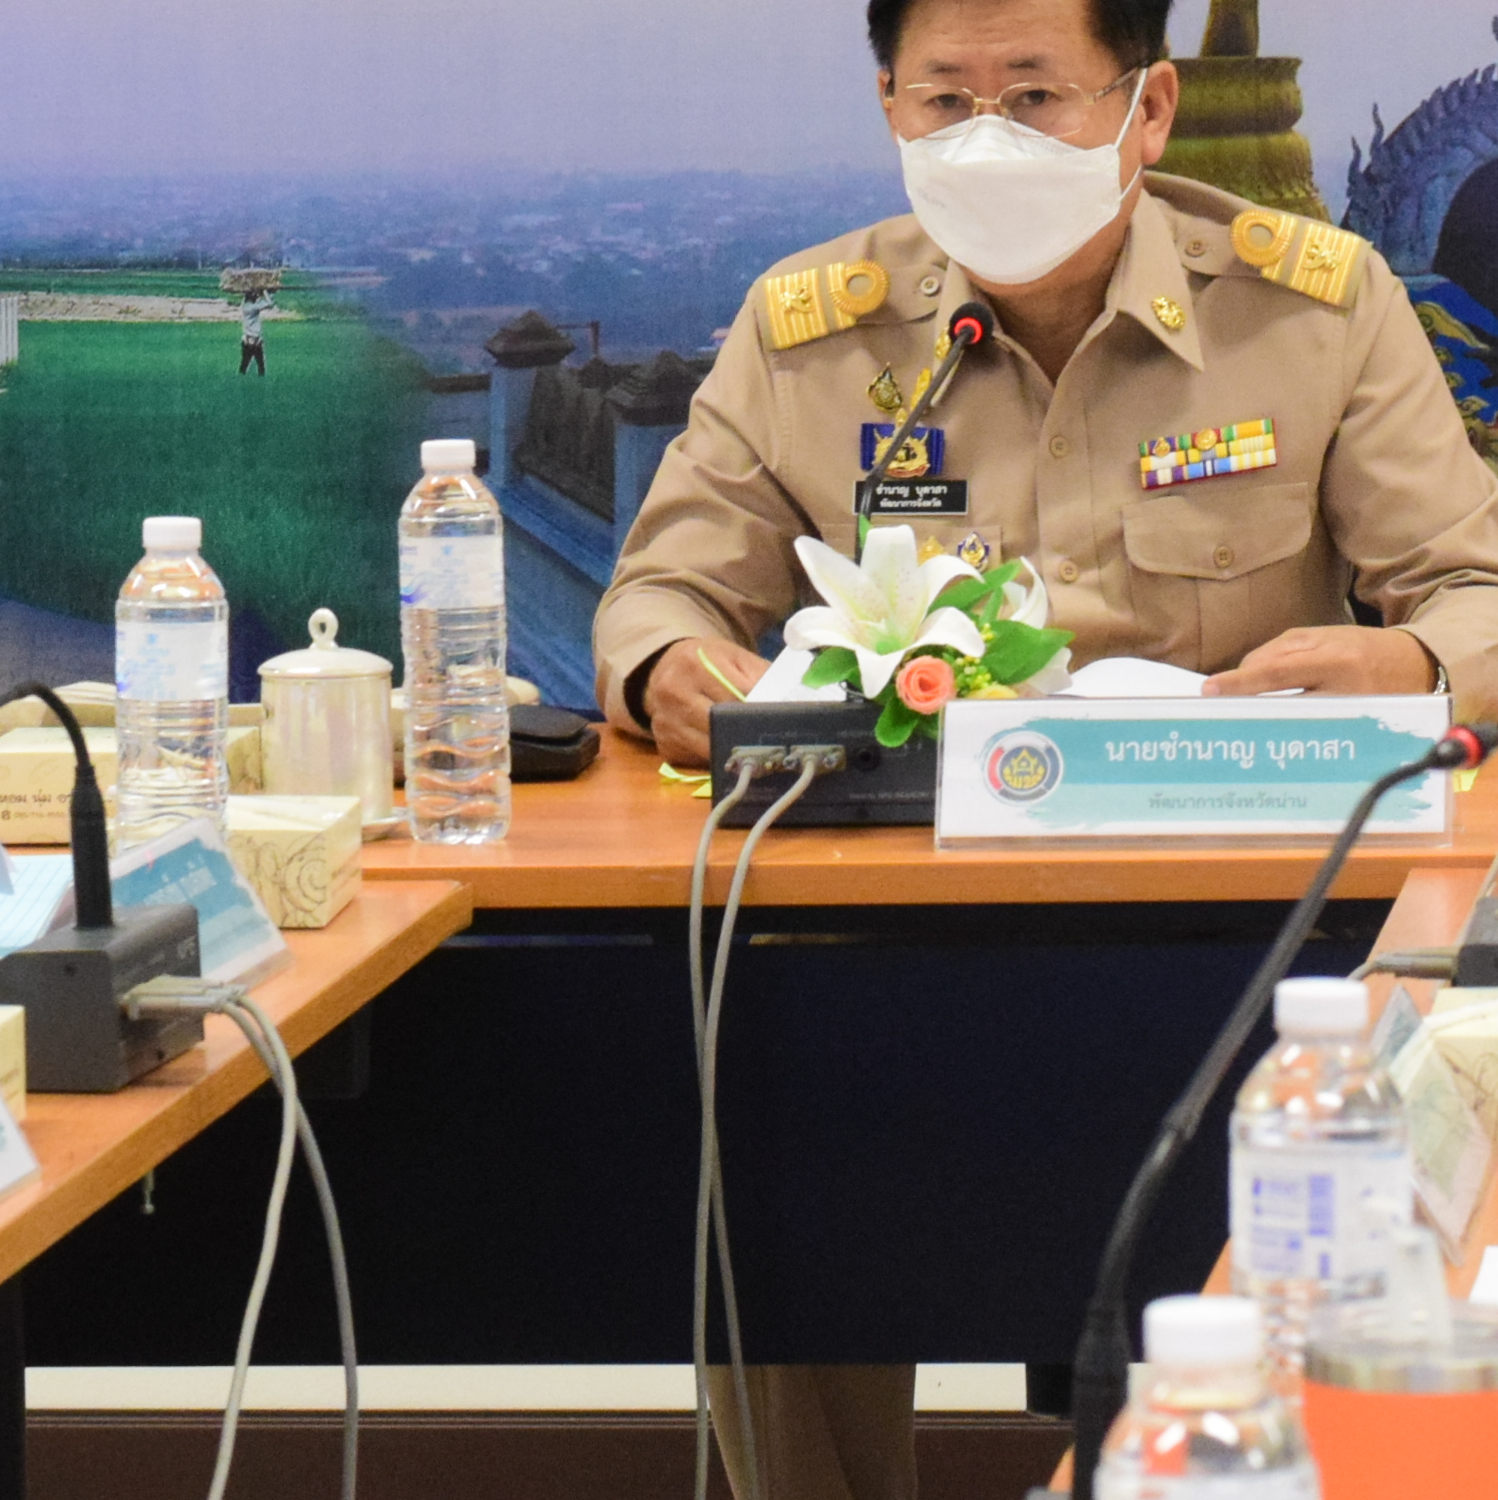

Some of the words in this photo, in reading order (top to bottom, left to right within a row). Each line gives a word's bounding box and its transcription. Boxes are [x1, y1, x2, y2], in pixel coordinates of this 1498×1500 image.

[1106, 731, 1255, 769] นายชำนาญ
[1266, 737, 1356, 769] บุดาสา
[1147, 790, 1308, 811] พัฒนาการจังหวัดน่าน
